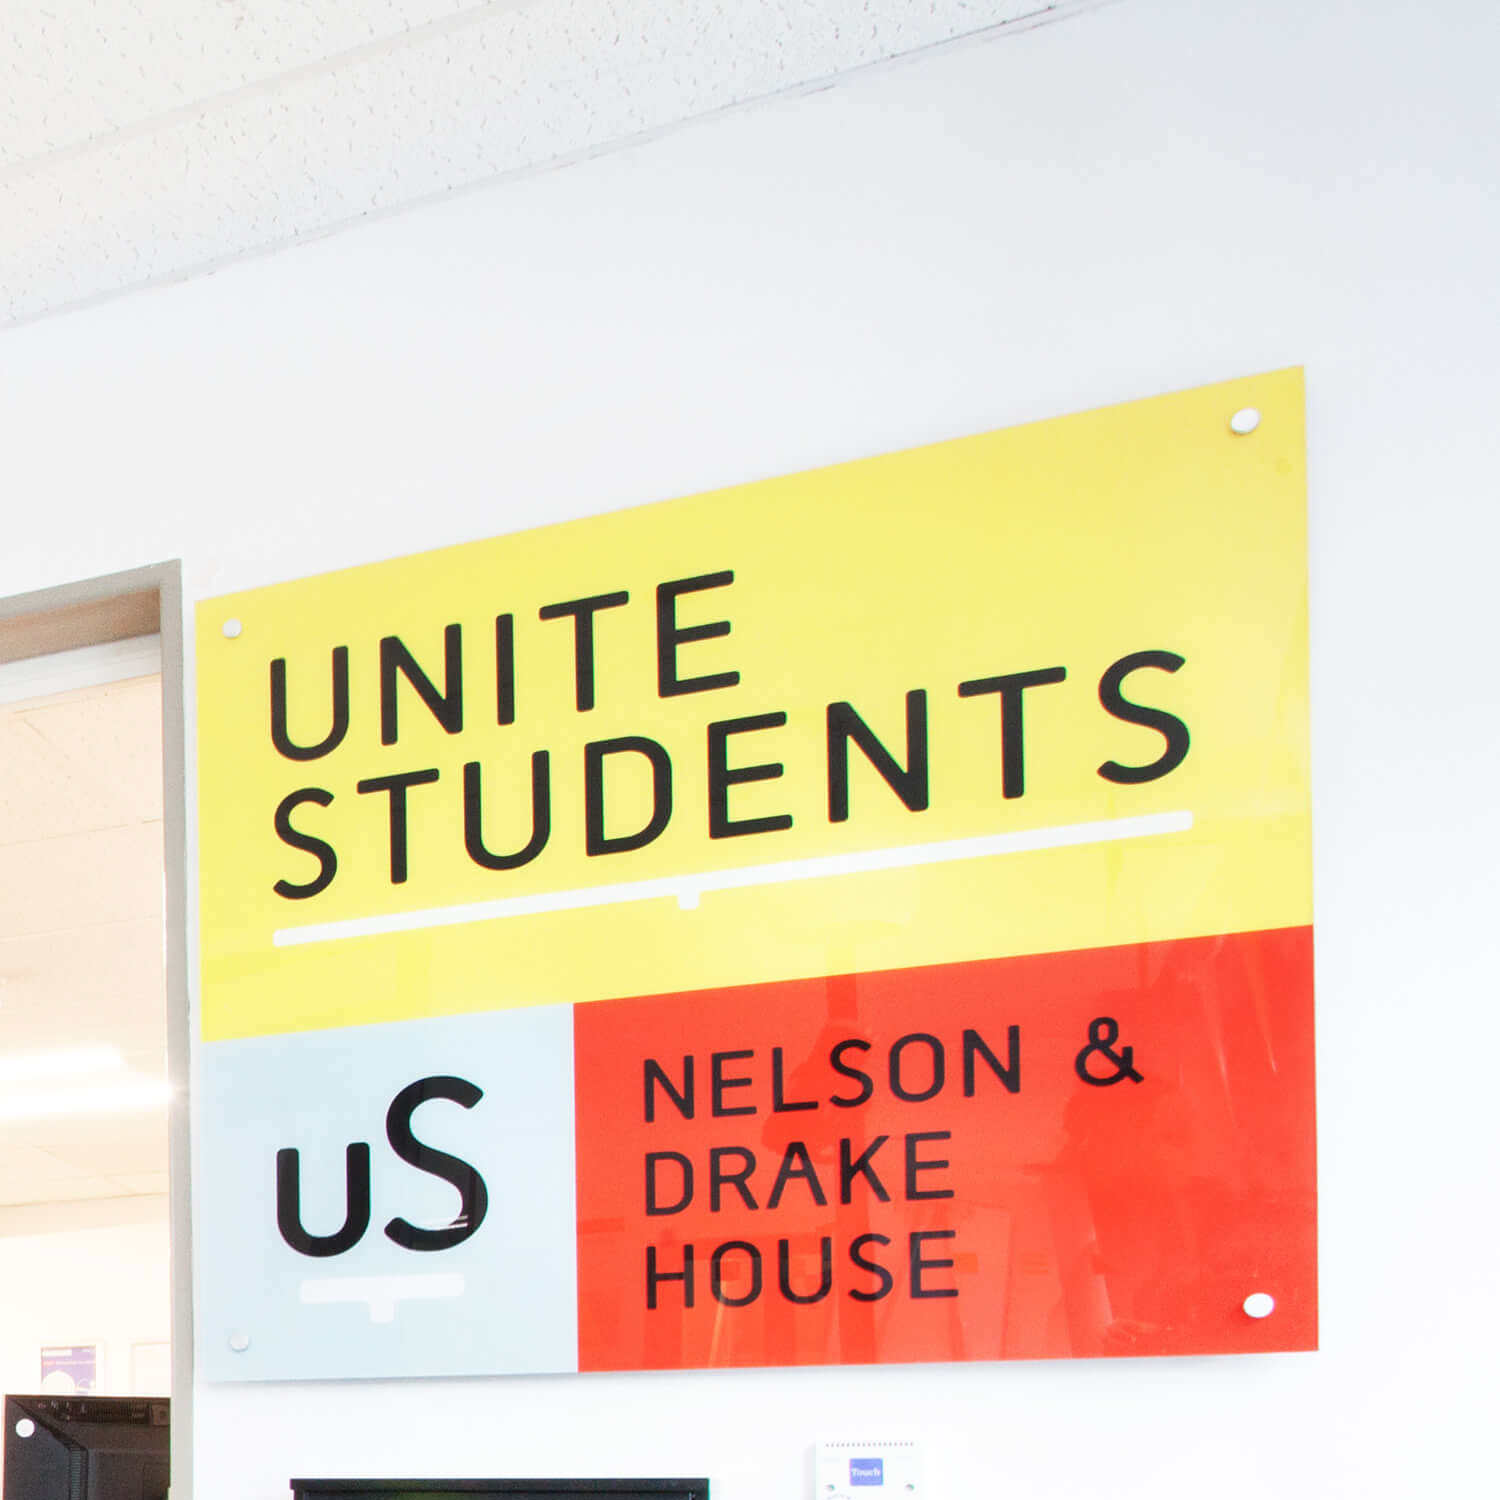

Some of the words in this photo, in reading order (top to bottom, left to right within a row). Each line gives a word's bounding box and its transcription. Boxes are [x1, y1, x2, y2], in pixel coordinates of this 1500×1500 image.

[270, 570, 741, 761] UNITE
[273, 650, 1191, 900] STUDENTS
[643, 1025, 1021, 1123] NELSON
[1075, 1016, 1145, 1087] &
[276, 1076, 489, 1258] uS
[644, 1131, 956, 1216] DRAKE
[645, 1230, 960, 1310] HOUSE
